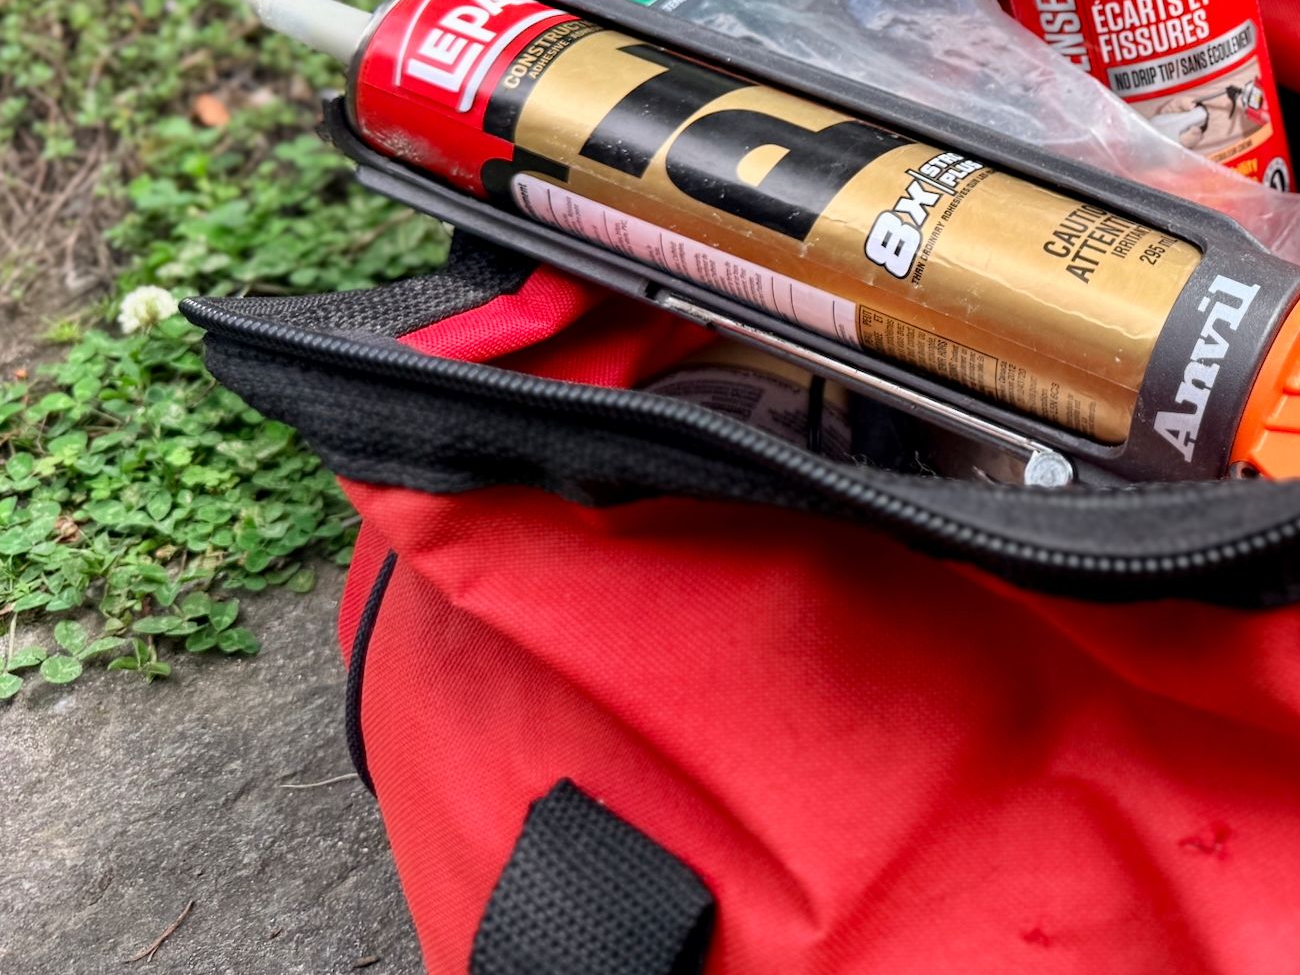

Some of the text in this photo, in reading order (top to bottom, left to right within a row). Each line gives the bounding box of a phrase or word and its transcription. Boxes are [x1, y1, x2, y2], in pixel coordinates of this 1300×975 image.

[1098, 10, 1210, 63] FISSURES
[528, 39, 568, 79] ADHESIVE
[1114, 71, 1130, 91] NO
[1131, 67, 1157, 89] DRIP
[1158, 62, 1175, 82] TIP
[1181, 51, 1207, 75] SANS
[1208, 26, 1251, 65] ÉCOULEMENT
[944, 159, 984, 189] PLUS
[1138, 237, 1178, 266] 295 mL
[907, 261, 930, 285] THAN
[1153, 274, 1261, 463] Anvil
